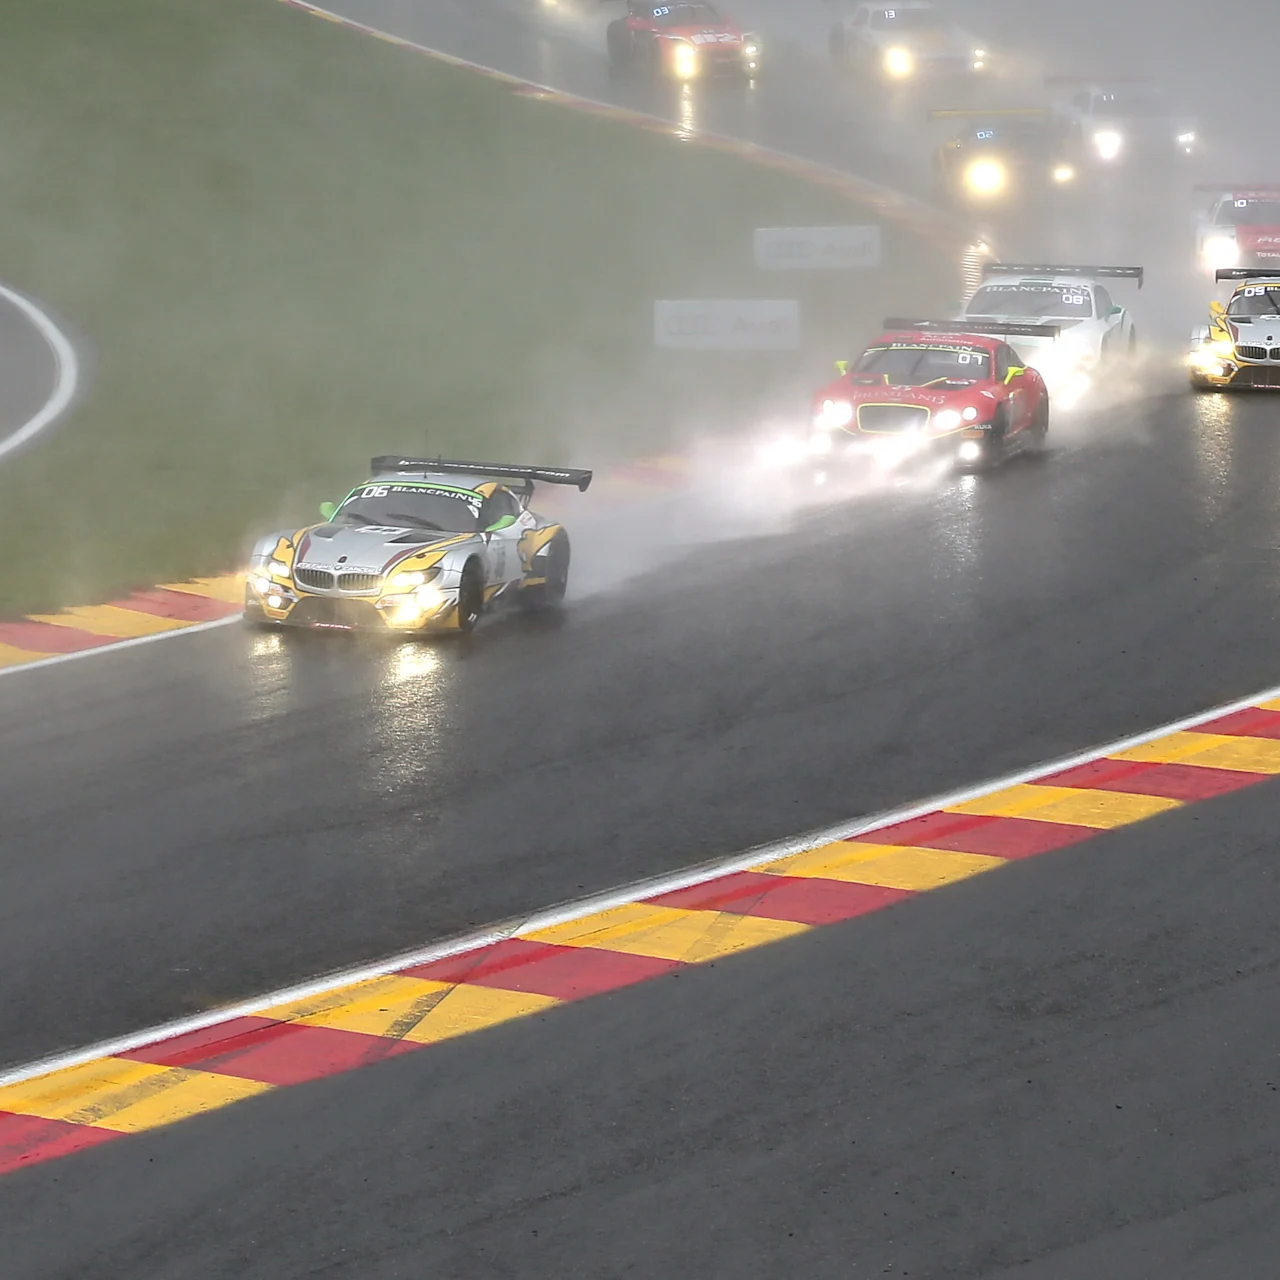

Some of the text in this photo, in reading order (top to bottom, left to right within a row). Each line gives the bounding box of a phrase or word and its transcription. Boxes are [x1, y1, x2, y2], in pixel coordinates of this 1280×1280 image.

[652, 6, 669, 18] 03
[884, 10, 897, 19] 13
[976, 130, 995, 140] 02
[1234, 199, 1247, 208] 10
[985, 286, 1084, 296] BLANCPAIN
[1244, 286, 1266, 298] 09
[1062, 294, 1084, 305] 08
[891, 341, 974, 352] BLANCPAIN
[361, 486, 391, 499] 06
[391, 486, 470, 503] BLANCPAIN
